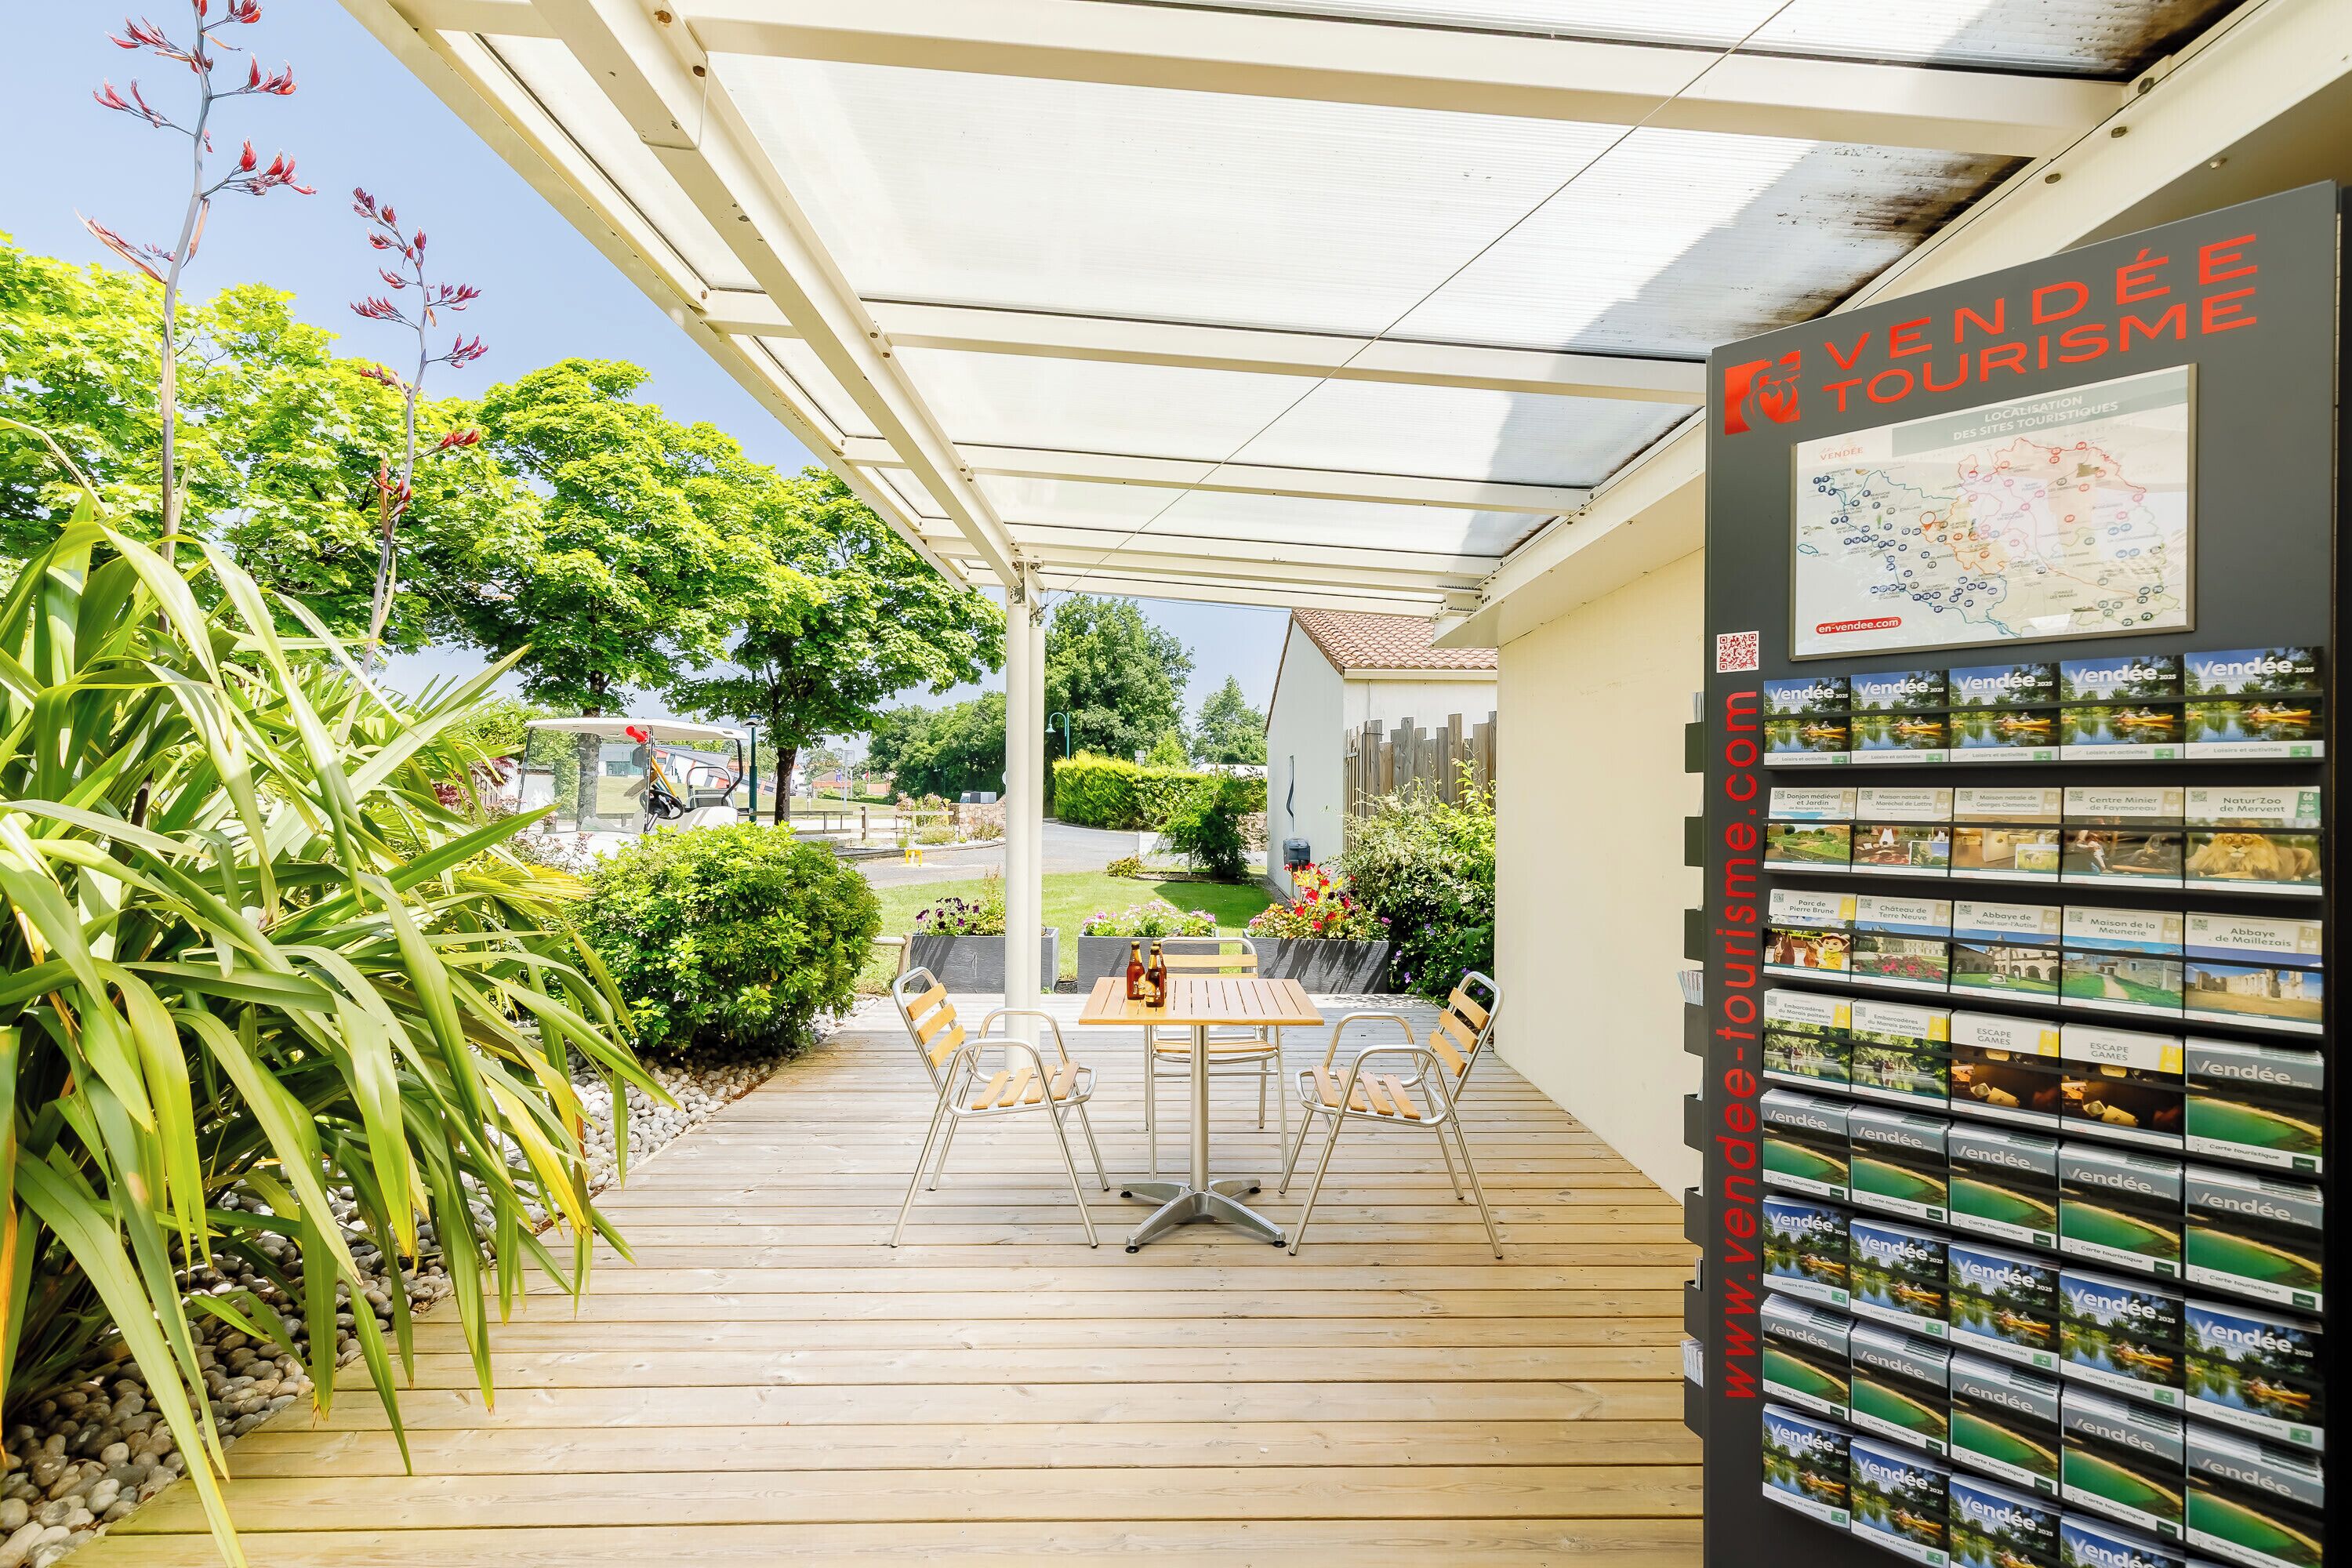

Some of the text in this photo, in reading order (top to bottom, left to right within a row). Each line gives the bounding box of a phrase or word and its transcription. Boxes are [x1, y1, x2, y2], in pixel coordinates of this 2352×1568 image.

[1824, 234, 2257, 371] VENDÉE
[1821, 287, 2257, 412] TOURISME
[1984, 395, 2082, 423] LOCALISATION
[1953, 401, 2118, 441] DES SITES TOURISTIQUES
[1820, 447, 1864, 460] VENDÉE
[1819, 619, 1898, 633] en-vendee.com
[2070, 665, 2158, 683] Vendée
[2196, 656, 2293, 677] Vendée
[1857, 679, 1928, 695] Vendée
[1958, 672, 2035, 690] Vendée
[1770, 685, 1834, 701] Vendée
[1983, 912, 2016, 920] Abbaye
[2099, 927, 2147, 936] Meunerie
[2230, 928, 2275, 938] Abbaye
[2233, 936, 2291, 946] Maillezais
[1784, 1004, 1824, 1012] Embarcadères
[1977, 1028, 2012, 1038] ESCAPE
[1978, 1036, 2010, 1045] GAMES
[1715, 690, 1758, 1398] www.vendee-tourisme.com
[2090, 1043, 2129, 1053] ESCAPE
[2092, 1051, 2128, 1061] GAMES
[2191, 1060, 2291, 1084] Vendée
[1765, 1109, 1828, 1130] Vendée
[1853, 1127, 1922, 1148] Vendée
[1954, 1145, 2031, 1169] Vendée
[2234, 1148, 2279, 1160] touristique
[2063, 1167, 2152, 1193] Vendée
[2191, 1192, 2290, 1220] Vendée
[1770, 1212, 1833, 1232] Vendée
[1857, 1233, 1928, 1261] Vendée
[2103, 1251, 2143, 1263] touristique
[1958, 1258, 2034, 1287] Vendée
[2210, 1275, 2280, 1294] Carte touristique
[2068, 1287, 2156, 1319] Vendée
[1765, 1321, 1828, 1348] Vendée
[2195, 1319, 2292, 1352] Vendée
[1855, 1349, 1925, 1378] Vendée
[1956, 1381, 2033, 1412] Vendée
[1769, 1421, 1834, 1452] Vendée
[2069, 1417, 2155, 1452] Vendée
[1857, 1457, 1927, 1490] Vendée
[2194, 1456, 2292, 1496] Vendée
[1958, 1492, 2036, 1531] Vendée
